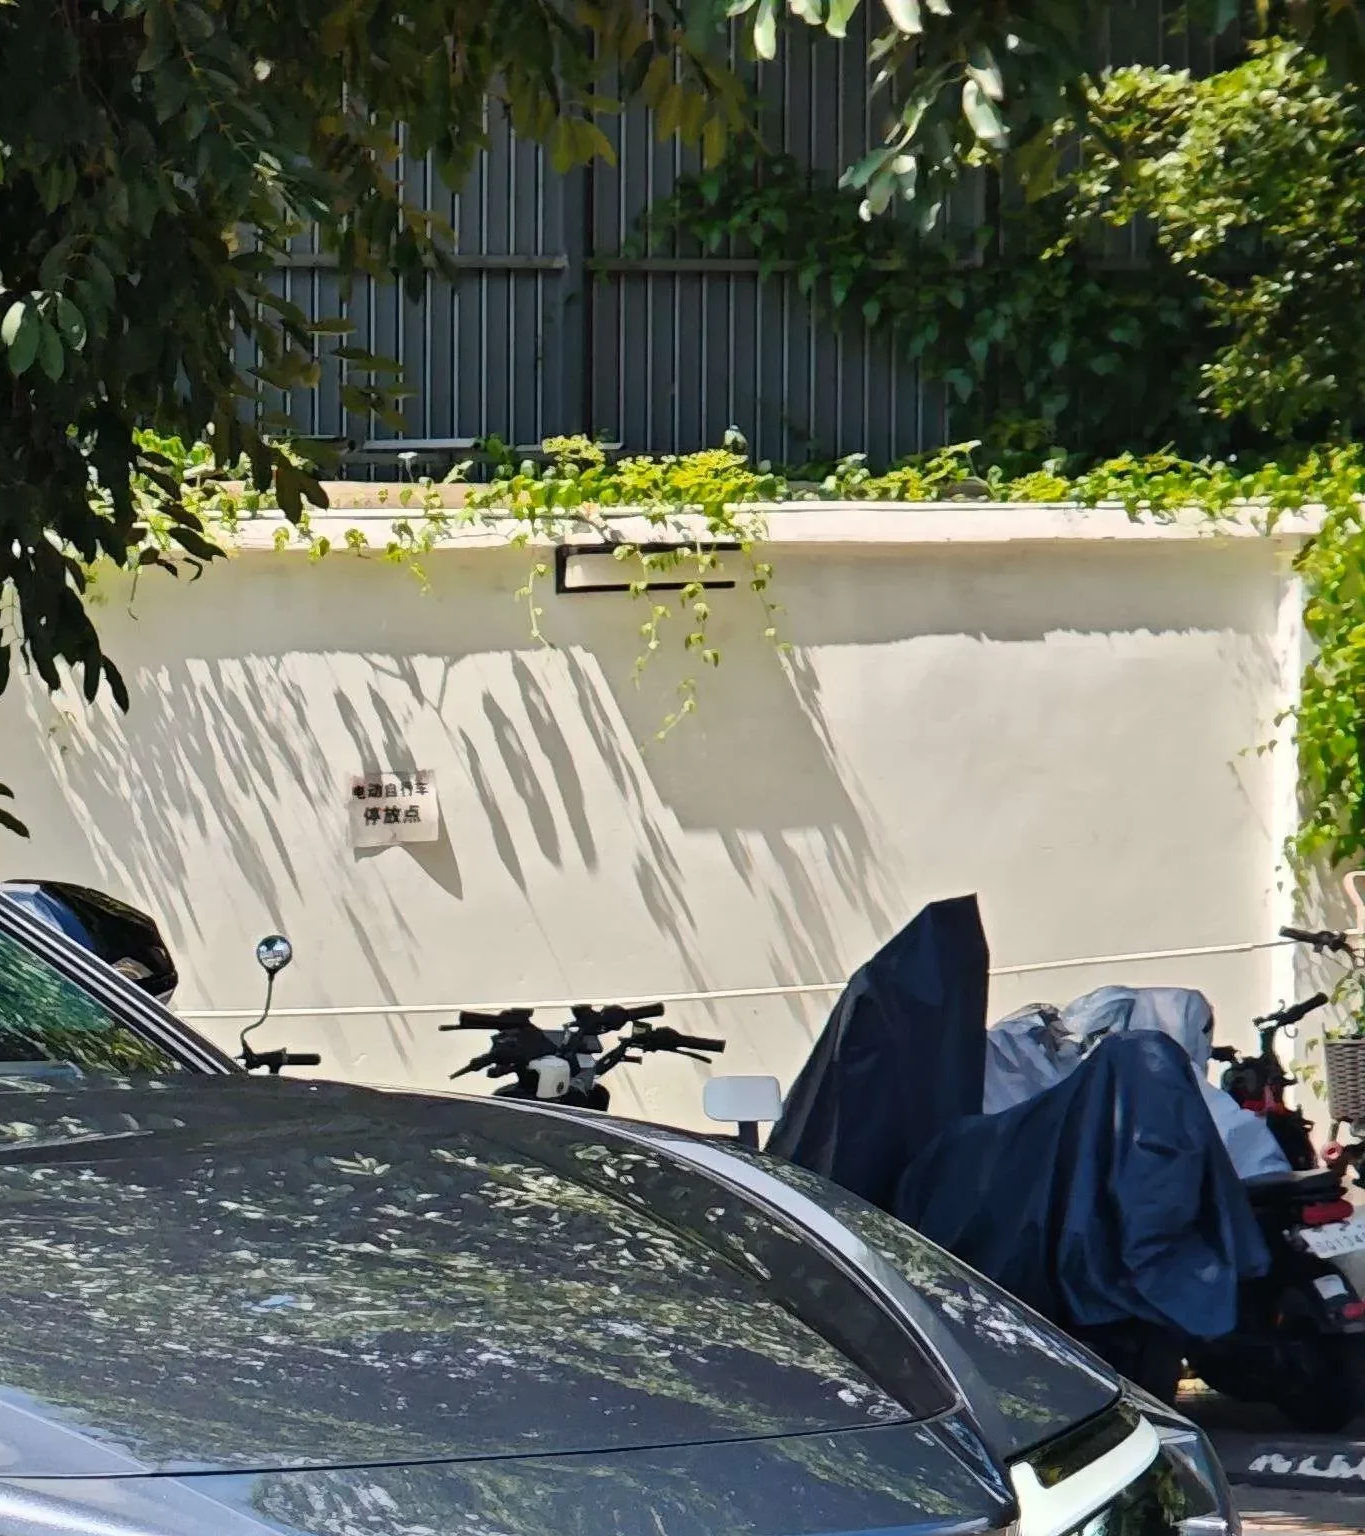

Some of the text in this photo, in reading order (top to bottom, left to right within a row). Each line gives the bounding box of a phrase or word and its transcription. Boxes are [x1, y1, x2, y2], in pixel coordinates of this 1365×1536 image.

[352, 781, 429, 799] 电动自行车
[364, 805, 421, 826] 停放点
